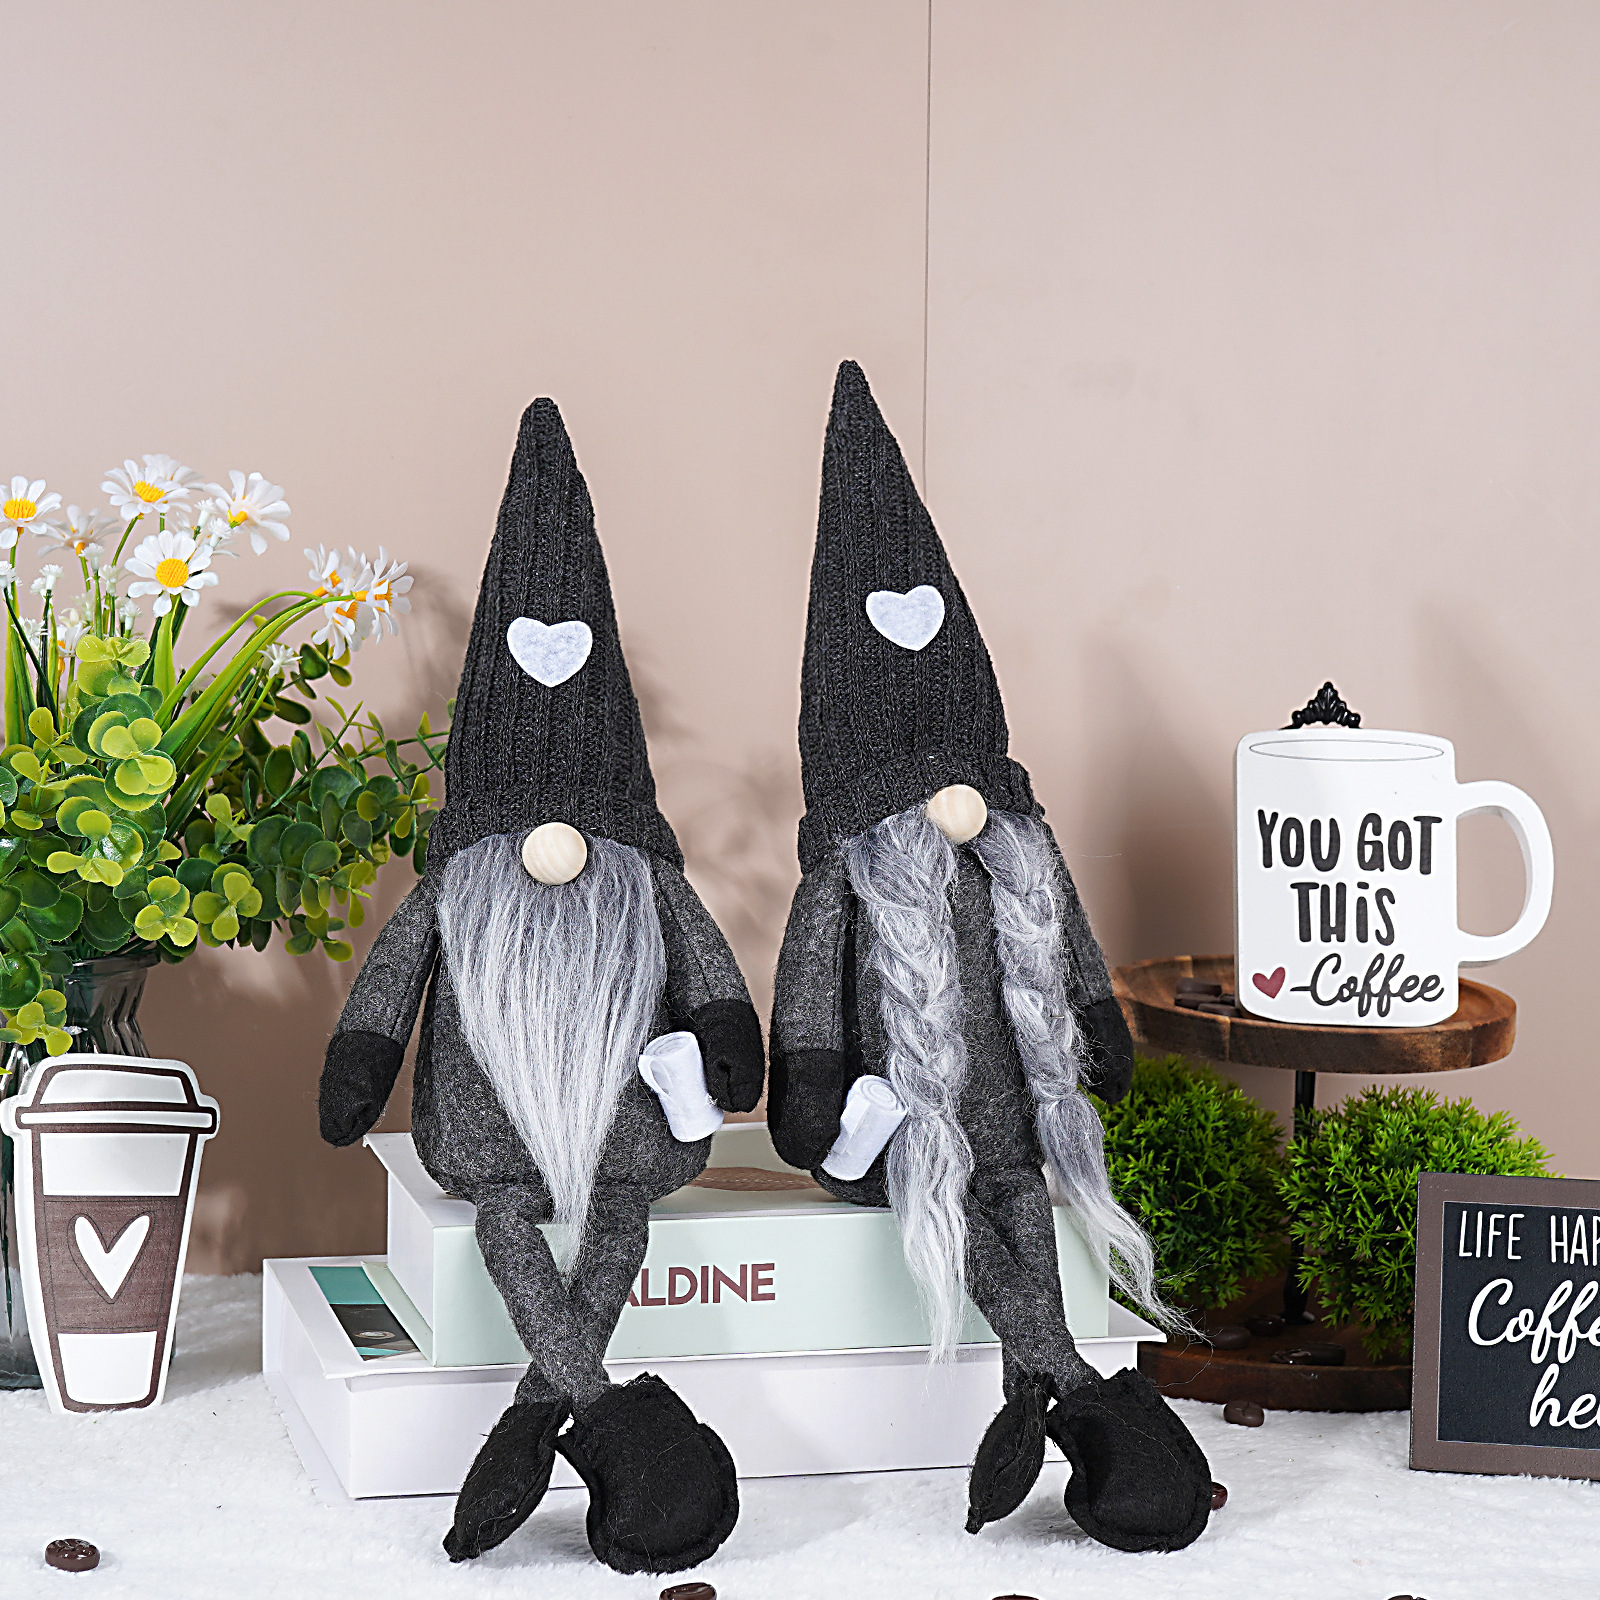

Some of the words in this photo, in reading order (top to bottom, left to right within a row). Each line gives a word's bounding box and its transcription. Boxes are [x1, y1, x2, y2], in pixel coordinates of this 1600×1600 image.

[1258, 809, 1340, 872] YOU
[1357, 813, 1442, 875] GOT
[1459, 1211, 1525, 1260] LIFE
[627, 1263, 776, 1307] LDINE
